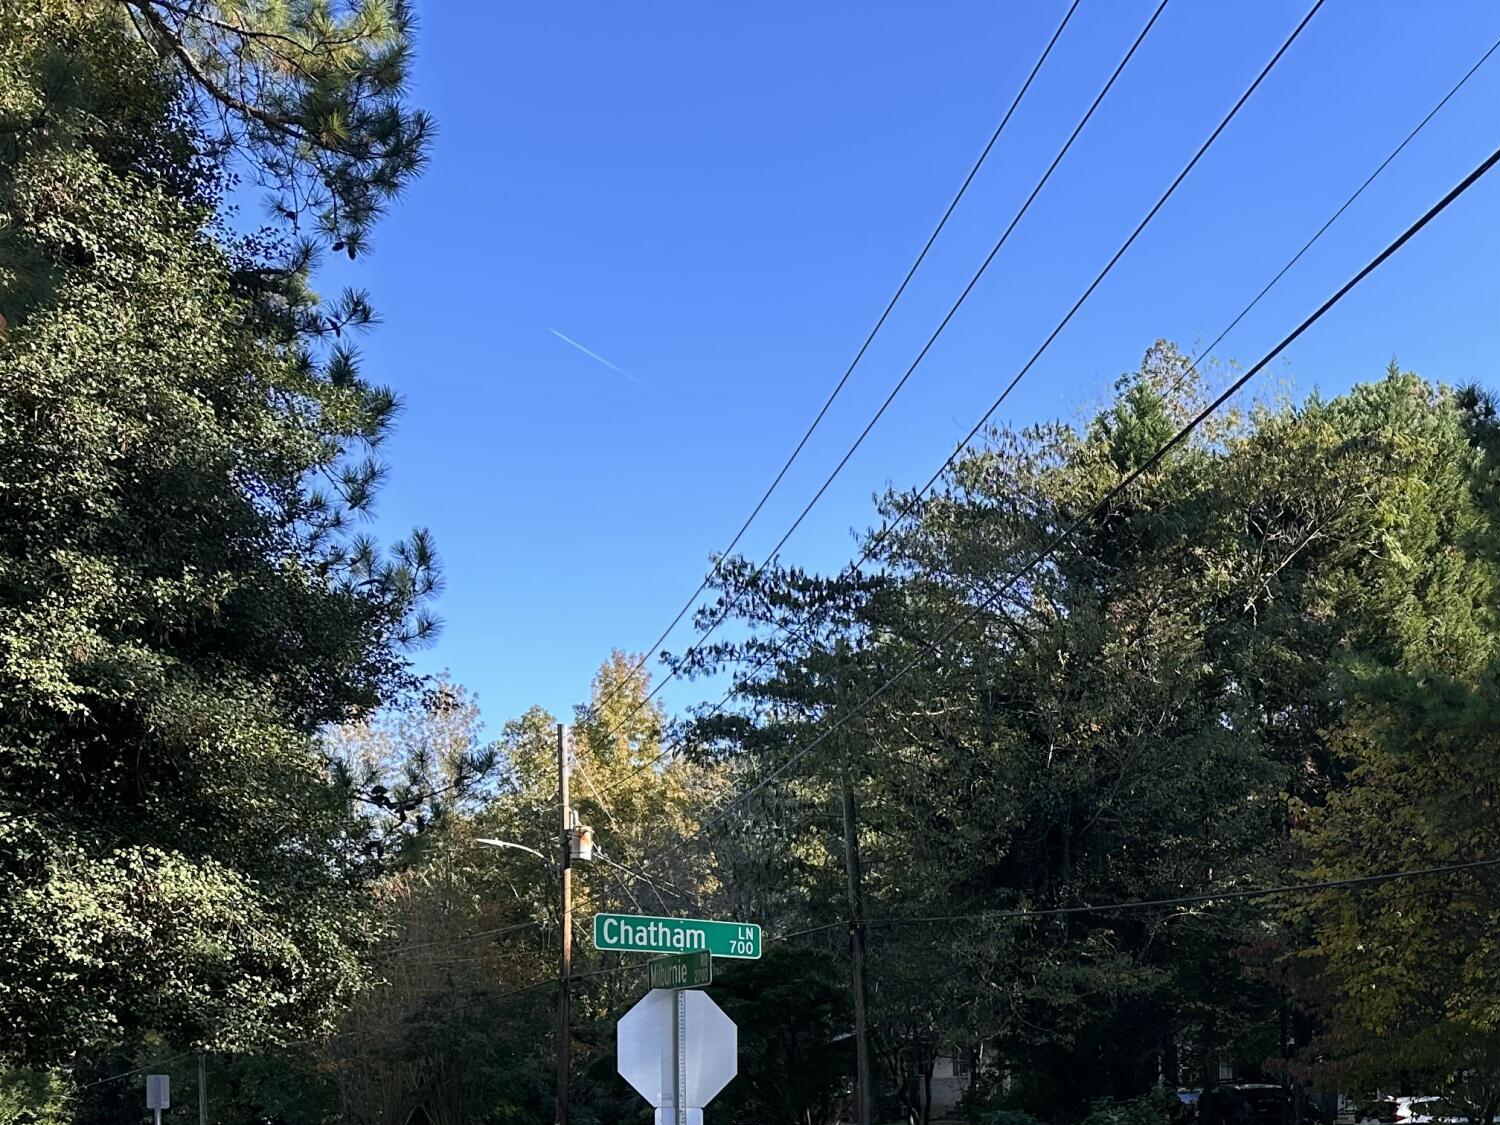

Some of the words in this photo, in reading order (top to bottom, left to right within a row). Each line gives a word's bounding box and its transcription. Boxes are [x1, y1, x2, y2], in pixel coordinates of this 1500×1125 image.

[603, 918, 706, 949] Chatham
[738, 926, 754, 940] LN
[729, 940, 754, 955] 700
[650, 959, 688, 987] Milburnie
